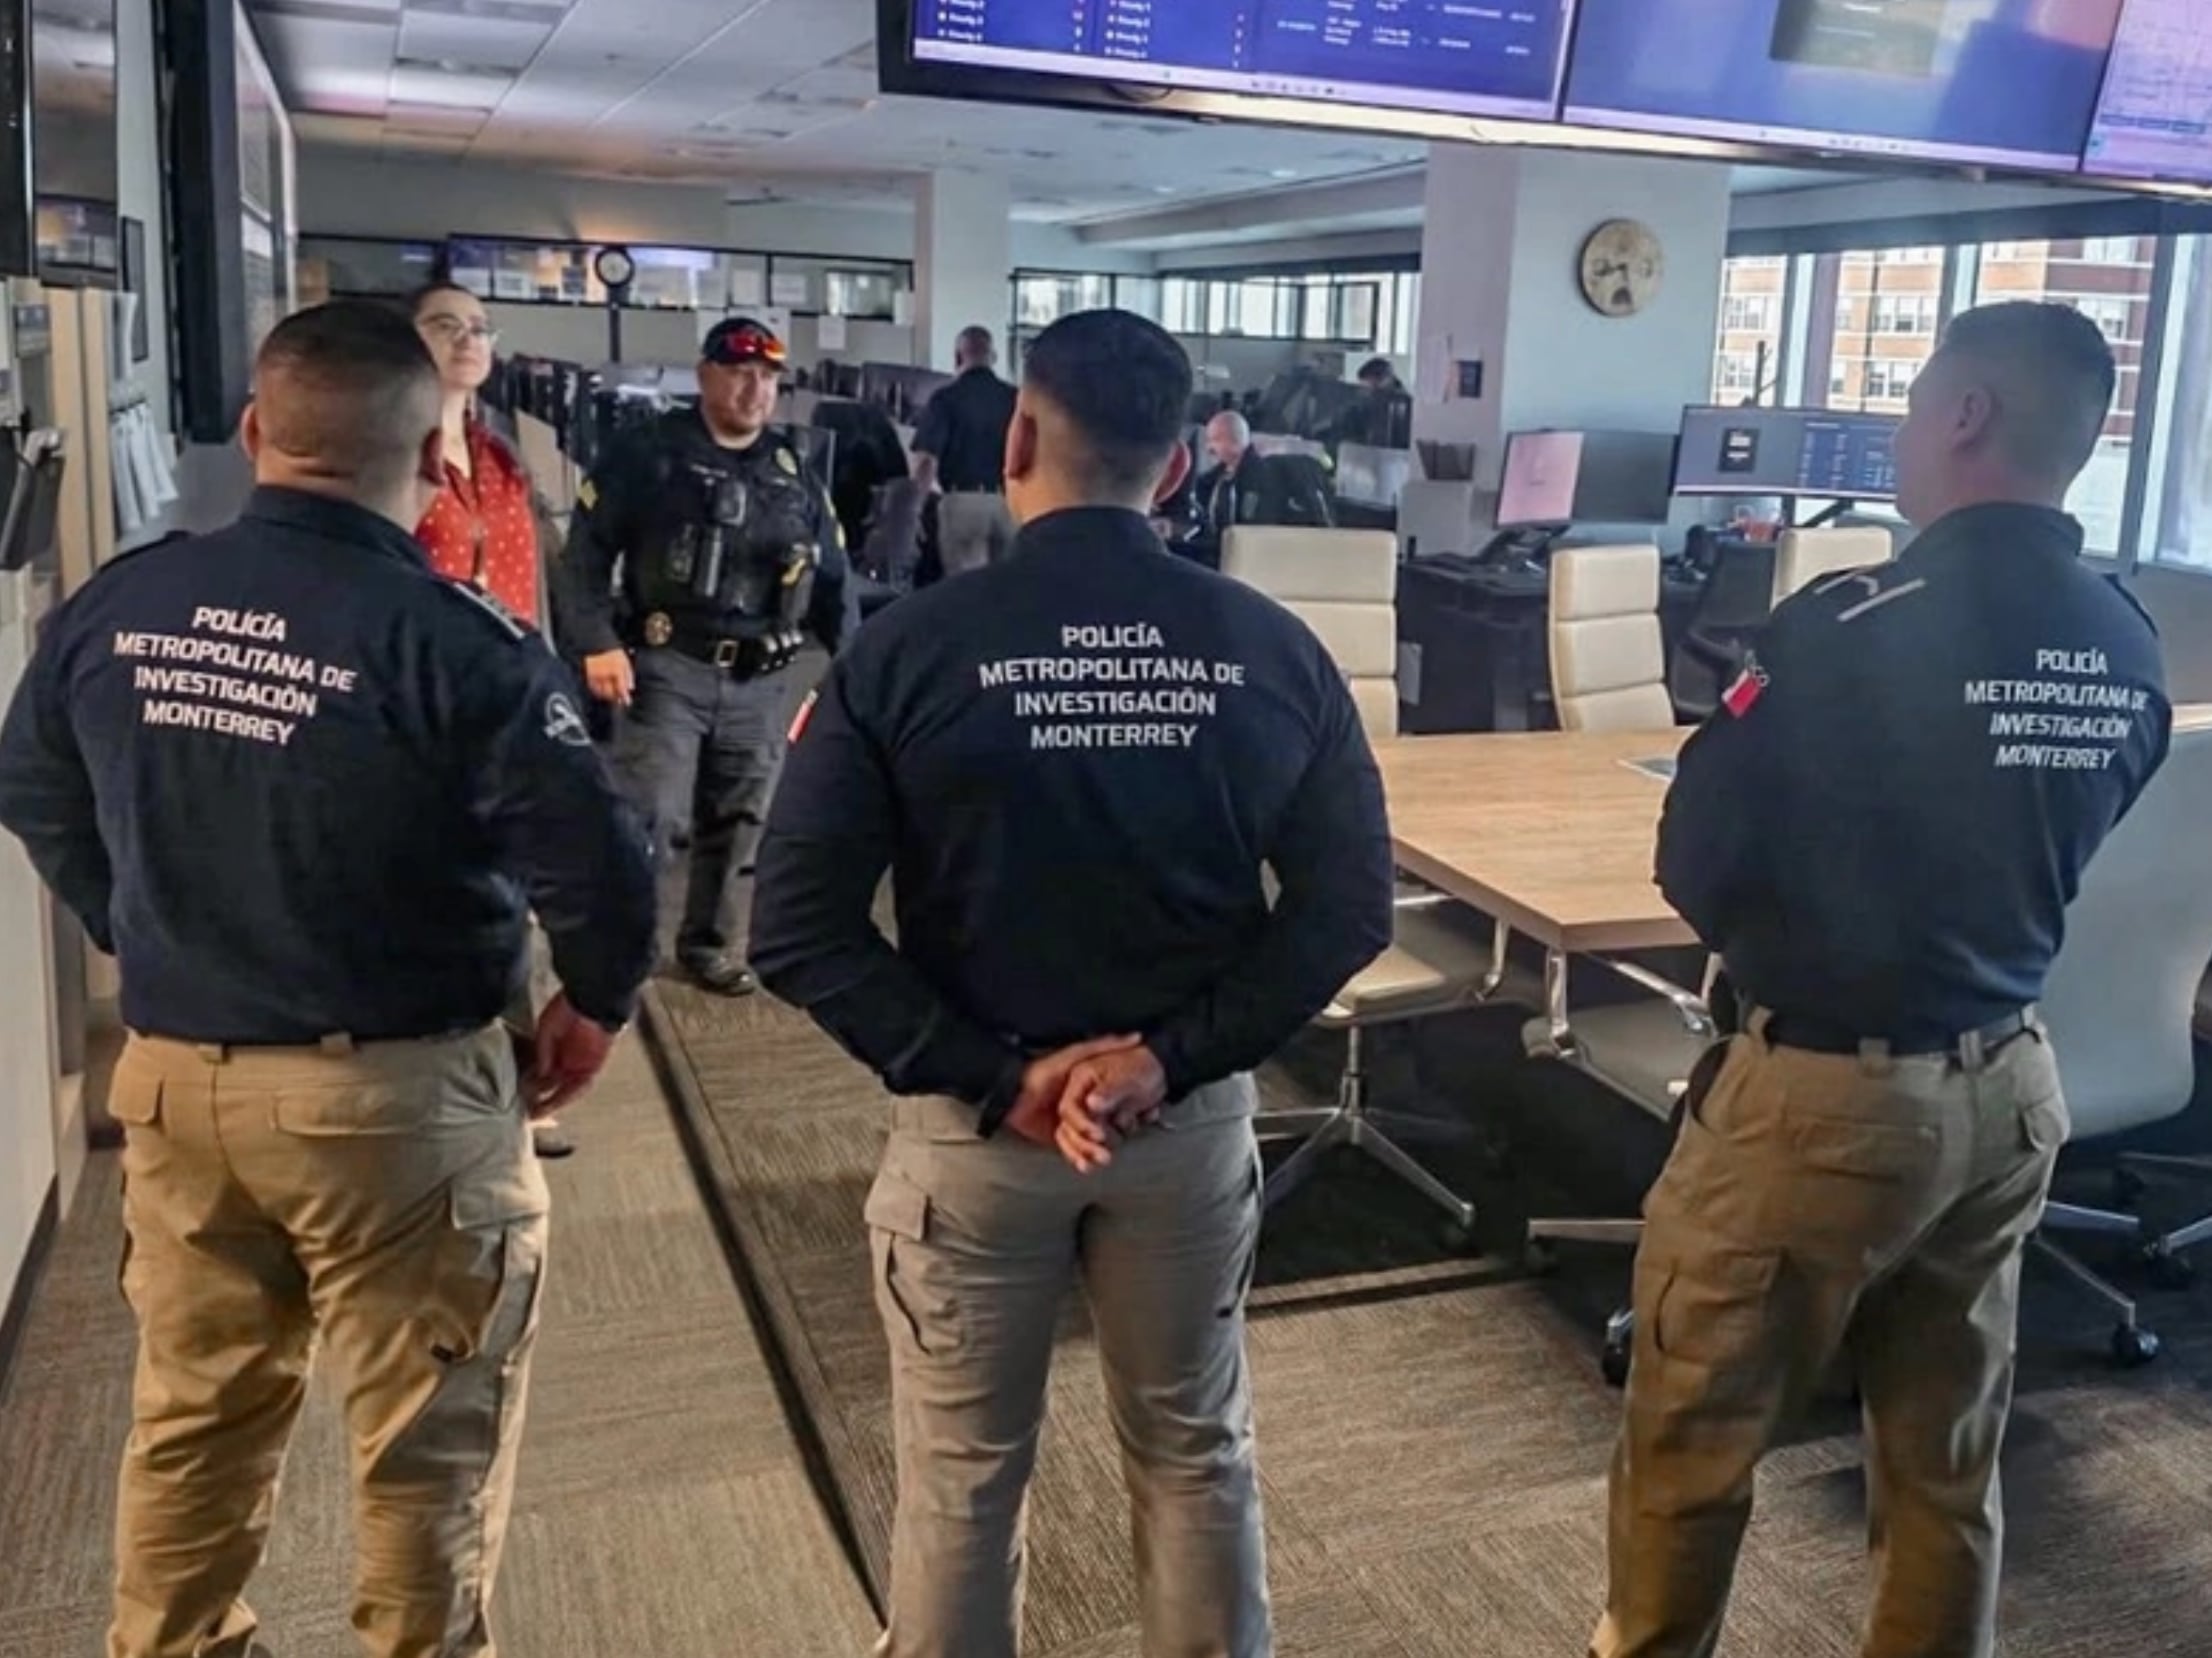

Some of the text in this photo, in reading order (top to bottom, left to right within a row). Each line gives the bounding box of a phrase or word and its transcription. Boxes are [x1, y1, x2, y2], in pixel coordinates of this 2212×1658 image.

[1061, 622, 1165, 648] POLICÍA
[114, 632, 358, 692] METROPOLITANA DE
[978, 657, 1245, 689] METROPOLITANA DE
[2035, 647, 2108, 675] POLICÍA
[134, 665, 317, 718] INVESTIGACIÓN
[1014, 687, 1217, 716] INVESTIGACIÓN
[1964, 680, 2150, 711] METROPOLITANA DE
[143, 698, 295, 746] MONTERREY
[1030, 724, 1199, 749] MONTERREY
[1989, 712, 2133, 739] INVESTIGACIÓN
[1994, 744, 2117, 770] MONTERREY
